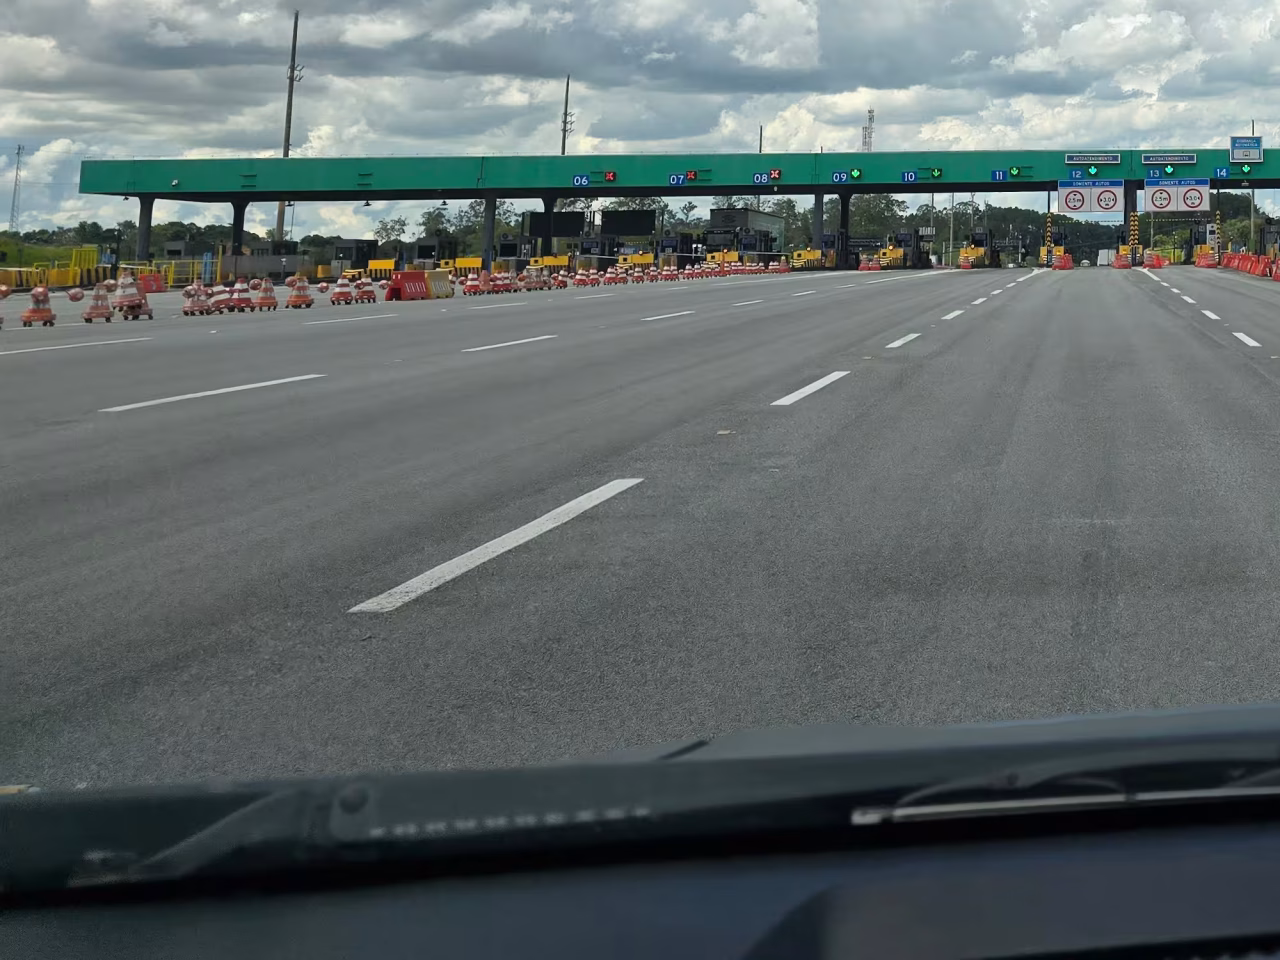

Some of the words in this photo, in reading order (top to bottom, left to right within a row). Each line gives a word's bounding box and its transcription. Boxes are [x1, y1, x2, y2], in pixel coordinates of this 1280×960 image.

[753, 173, 768, 183] 08
[832, 172, 847, 182] 09
[904, 172, 915, 181] 10
[995, 171, 1003, 180] 11
[1072, 170, 1082, 179] 12
[1150, 170, 1160, 178] 13
[1216, 168, 1227, 178] 14
[573, 176, 588, 186] 06
[670, 175, 684, 185] 07
